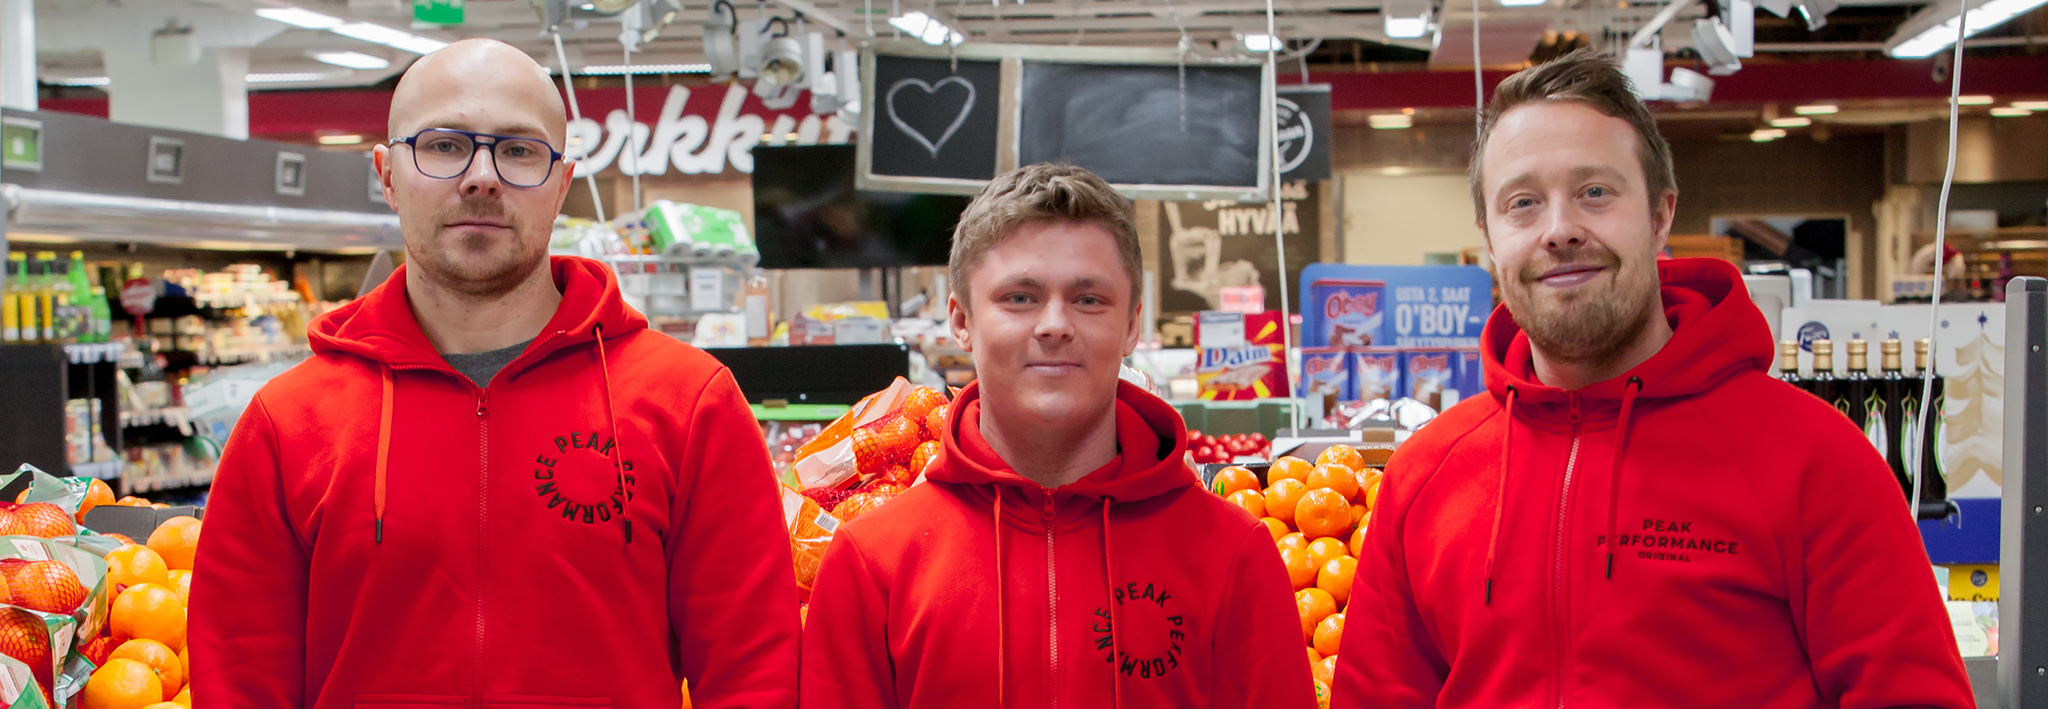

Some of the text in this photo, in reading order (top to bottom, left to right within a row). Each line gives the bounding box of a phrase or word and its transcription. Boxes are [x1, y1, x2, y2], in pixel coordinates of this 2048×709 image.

[1395, 303, 1481, 336] O'BOY-
[1204, 342, 1269, 369] Daim
[534, 432, 635, 524] PEAK PERFORMANCE
[1643, 519, 1693, 534] PEAK
[1597, 535, 1739, 555] PRFORMANCE
[1638, 551, 1691, 562] ORIGINAL
[1114, 582, 1171, 608] PEAK
